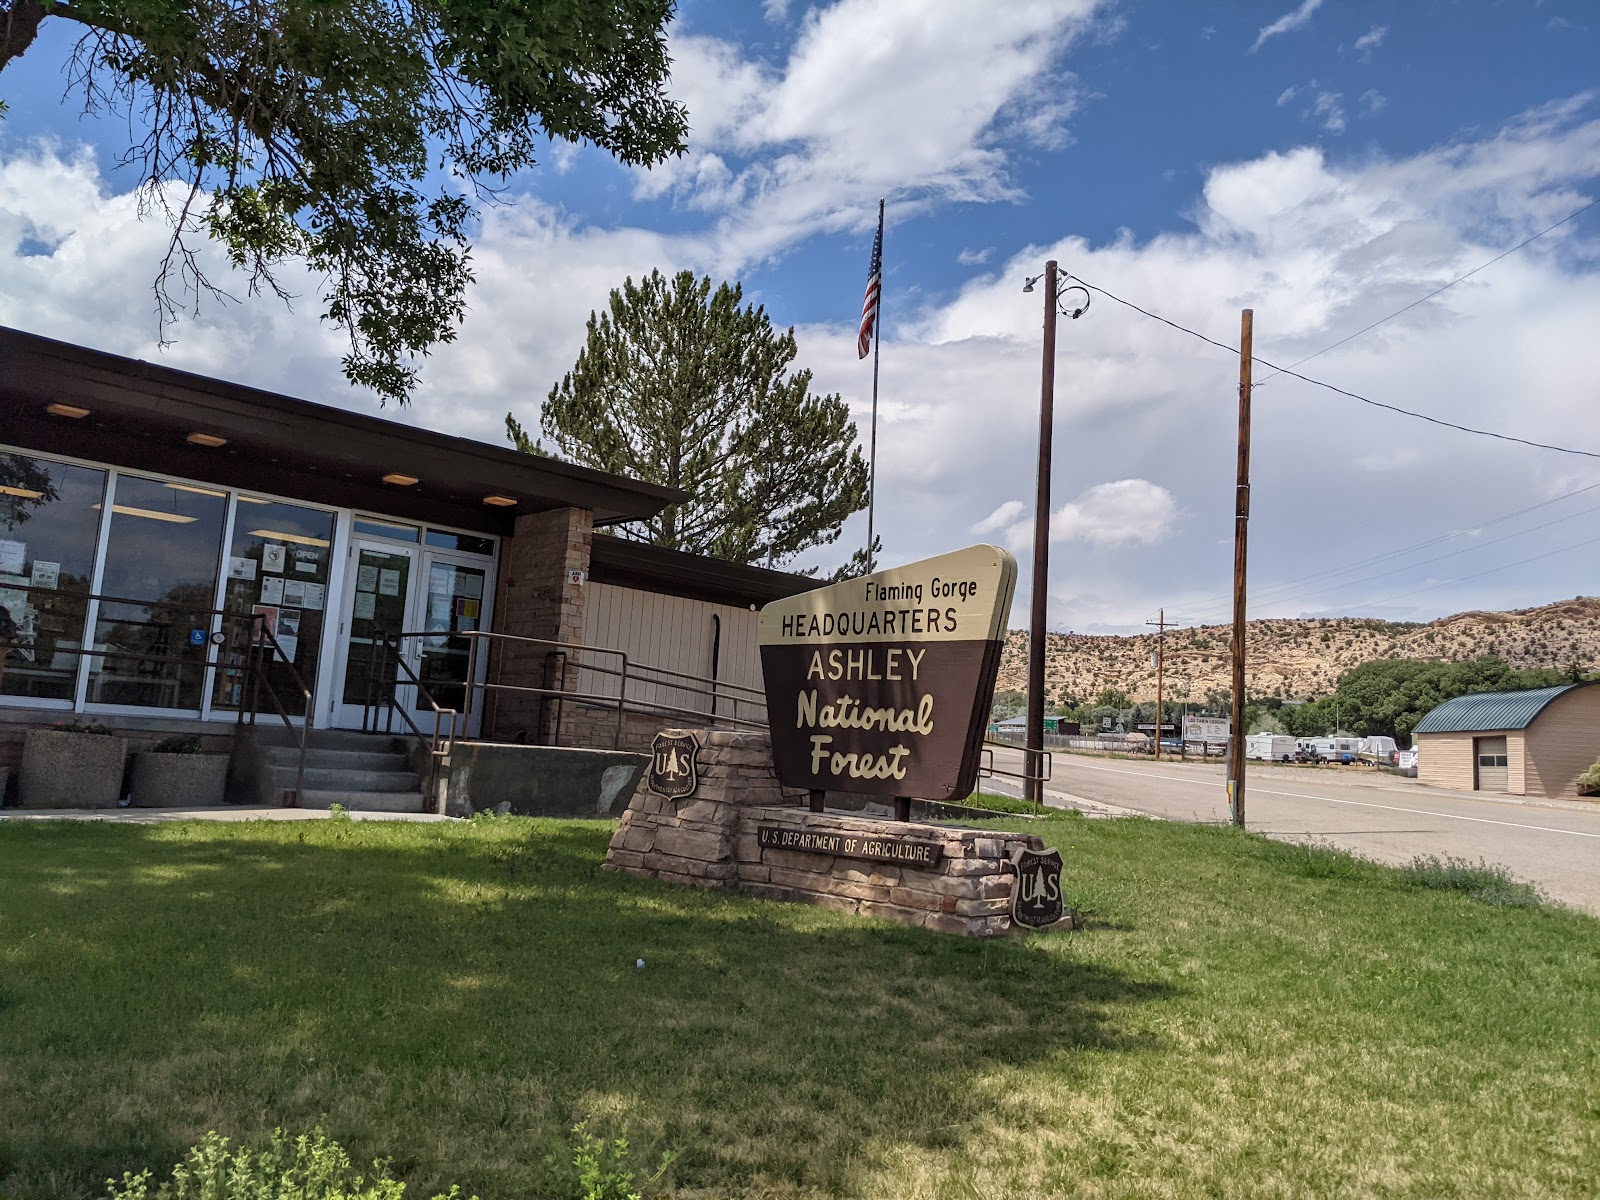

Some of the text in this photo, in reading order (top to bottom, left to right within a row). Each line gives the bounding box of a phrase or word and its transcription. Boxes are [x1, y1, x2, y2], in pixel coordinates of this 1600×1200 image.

[296, 550, 319, 560] OPEN
[866, 578, 978, 604] Flaming Gorge
[782, 608, 958, 637] HEADQUARTERS
[807, 648, 926, 680] ASHLEY
[797, 689, 934, 735] National
[655, 740, 692, 752] FOREST SERVICE
[810, 734, 911, 780] Forest
[782, 832, 841, 851] DEPARTMENT
[844, 838, 858, 853] OF
[861, 841, 931, 862] AGRICULTURE
[1021, 856, 1060, 871] FOREST SERVICE
